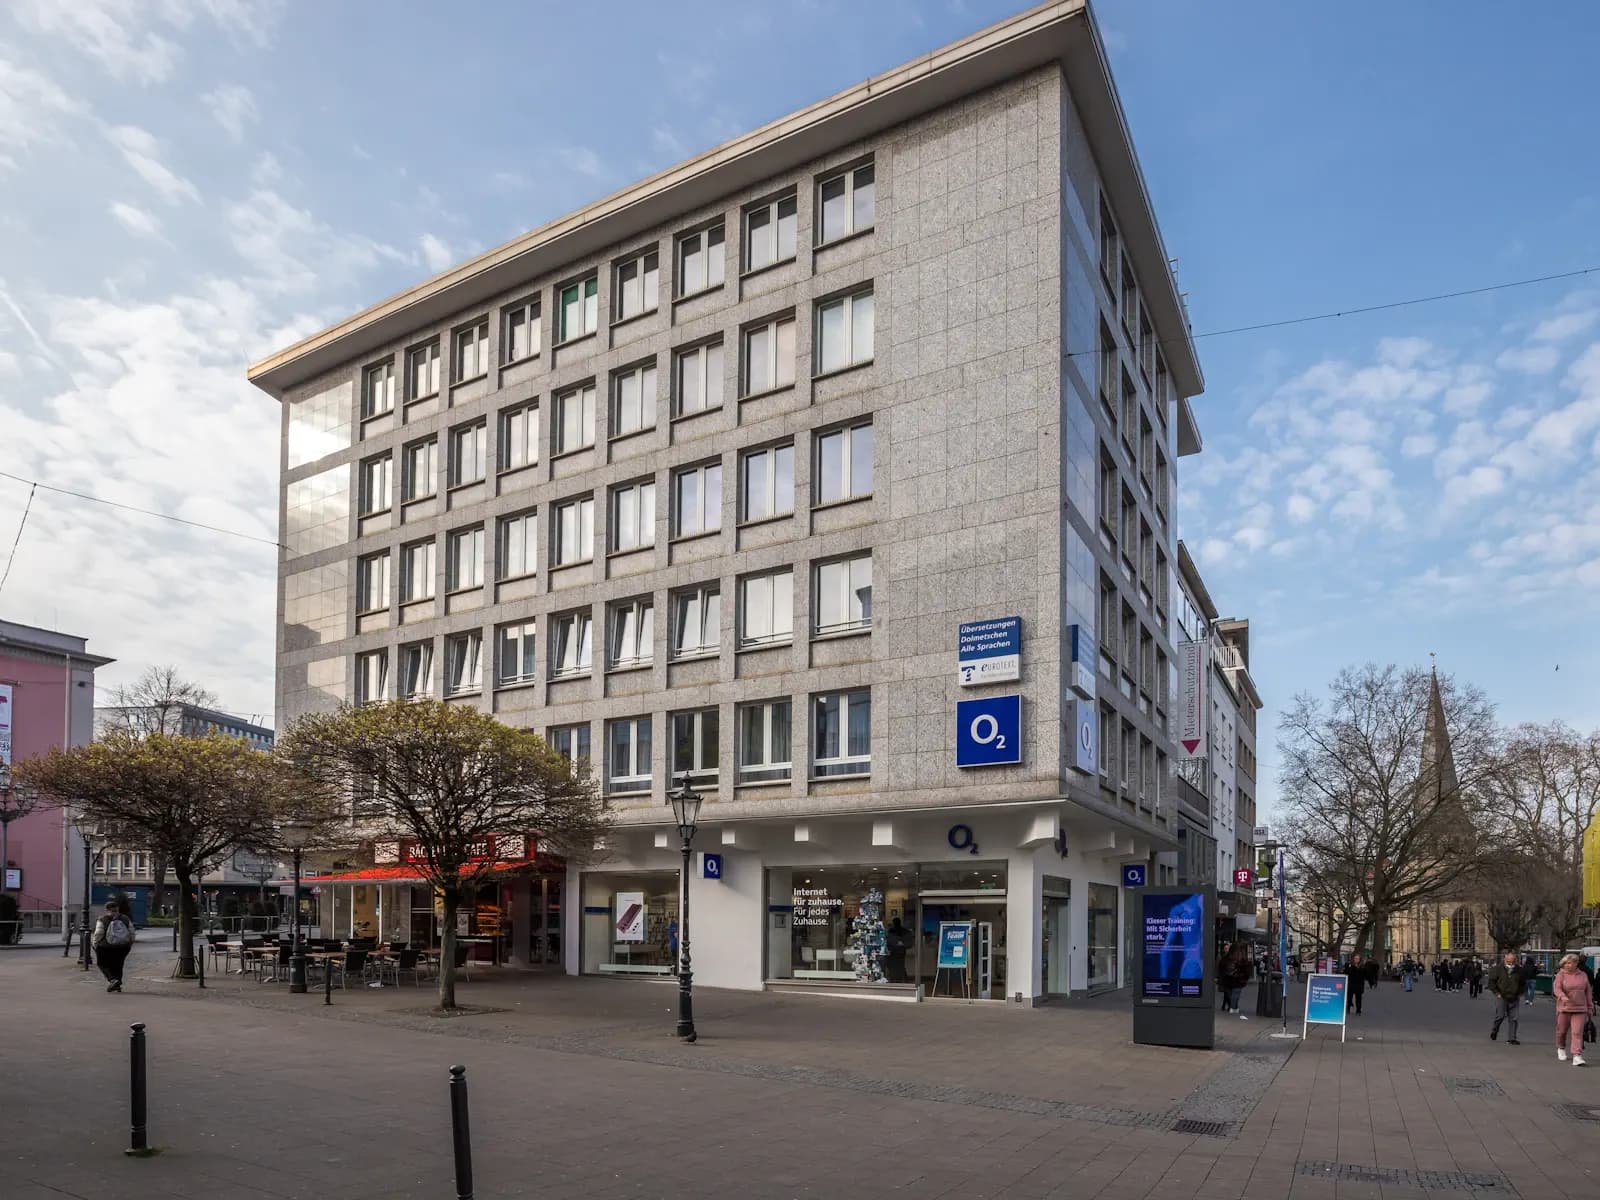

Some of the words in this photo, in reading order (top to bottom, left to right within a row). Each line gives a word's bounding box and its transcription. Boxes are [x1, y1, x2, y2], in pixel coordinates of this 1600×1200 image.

[961, 620, 1016, 633] Übersetzungen
[961, 631, 1008, 643] Dolmetschen
[961, 645, 975, 653] Alle
[977, 641, 1011, 652] Sprachen
[1184, 646, 1195, 737] Mieterschutzbund
[793, 888, 828, 896] Internet
[807, 897, 845, 906] zuhause.
[793, 906, 807, 916] Für
[808, 908, 830, 918] jedes
[1158, 925, 1192, 933] Sicherheit
